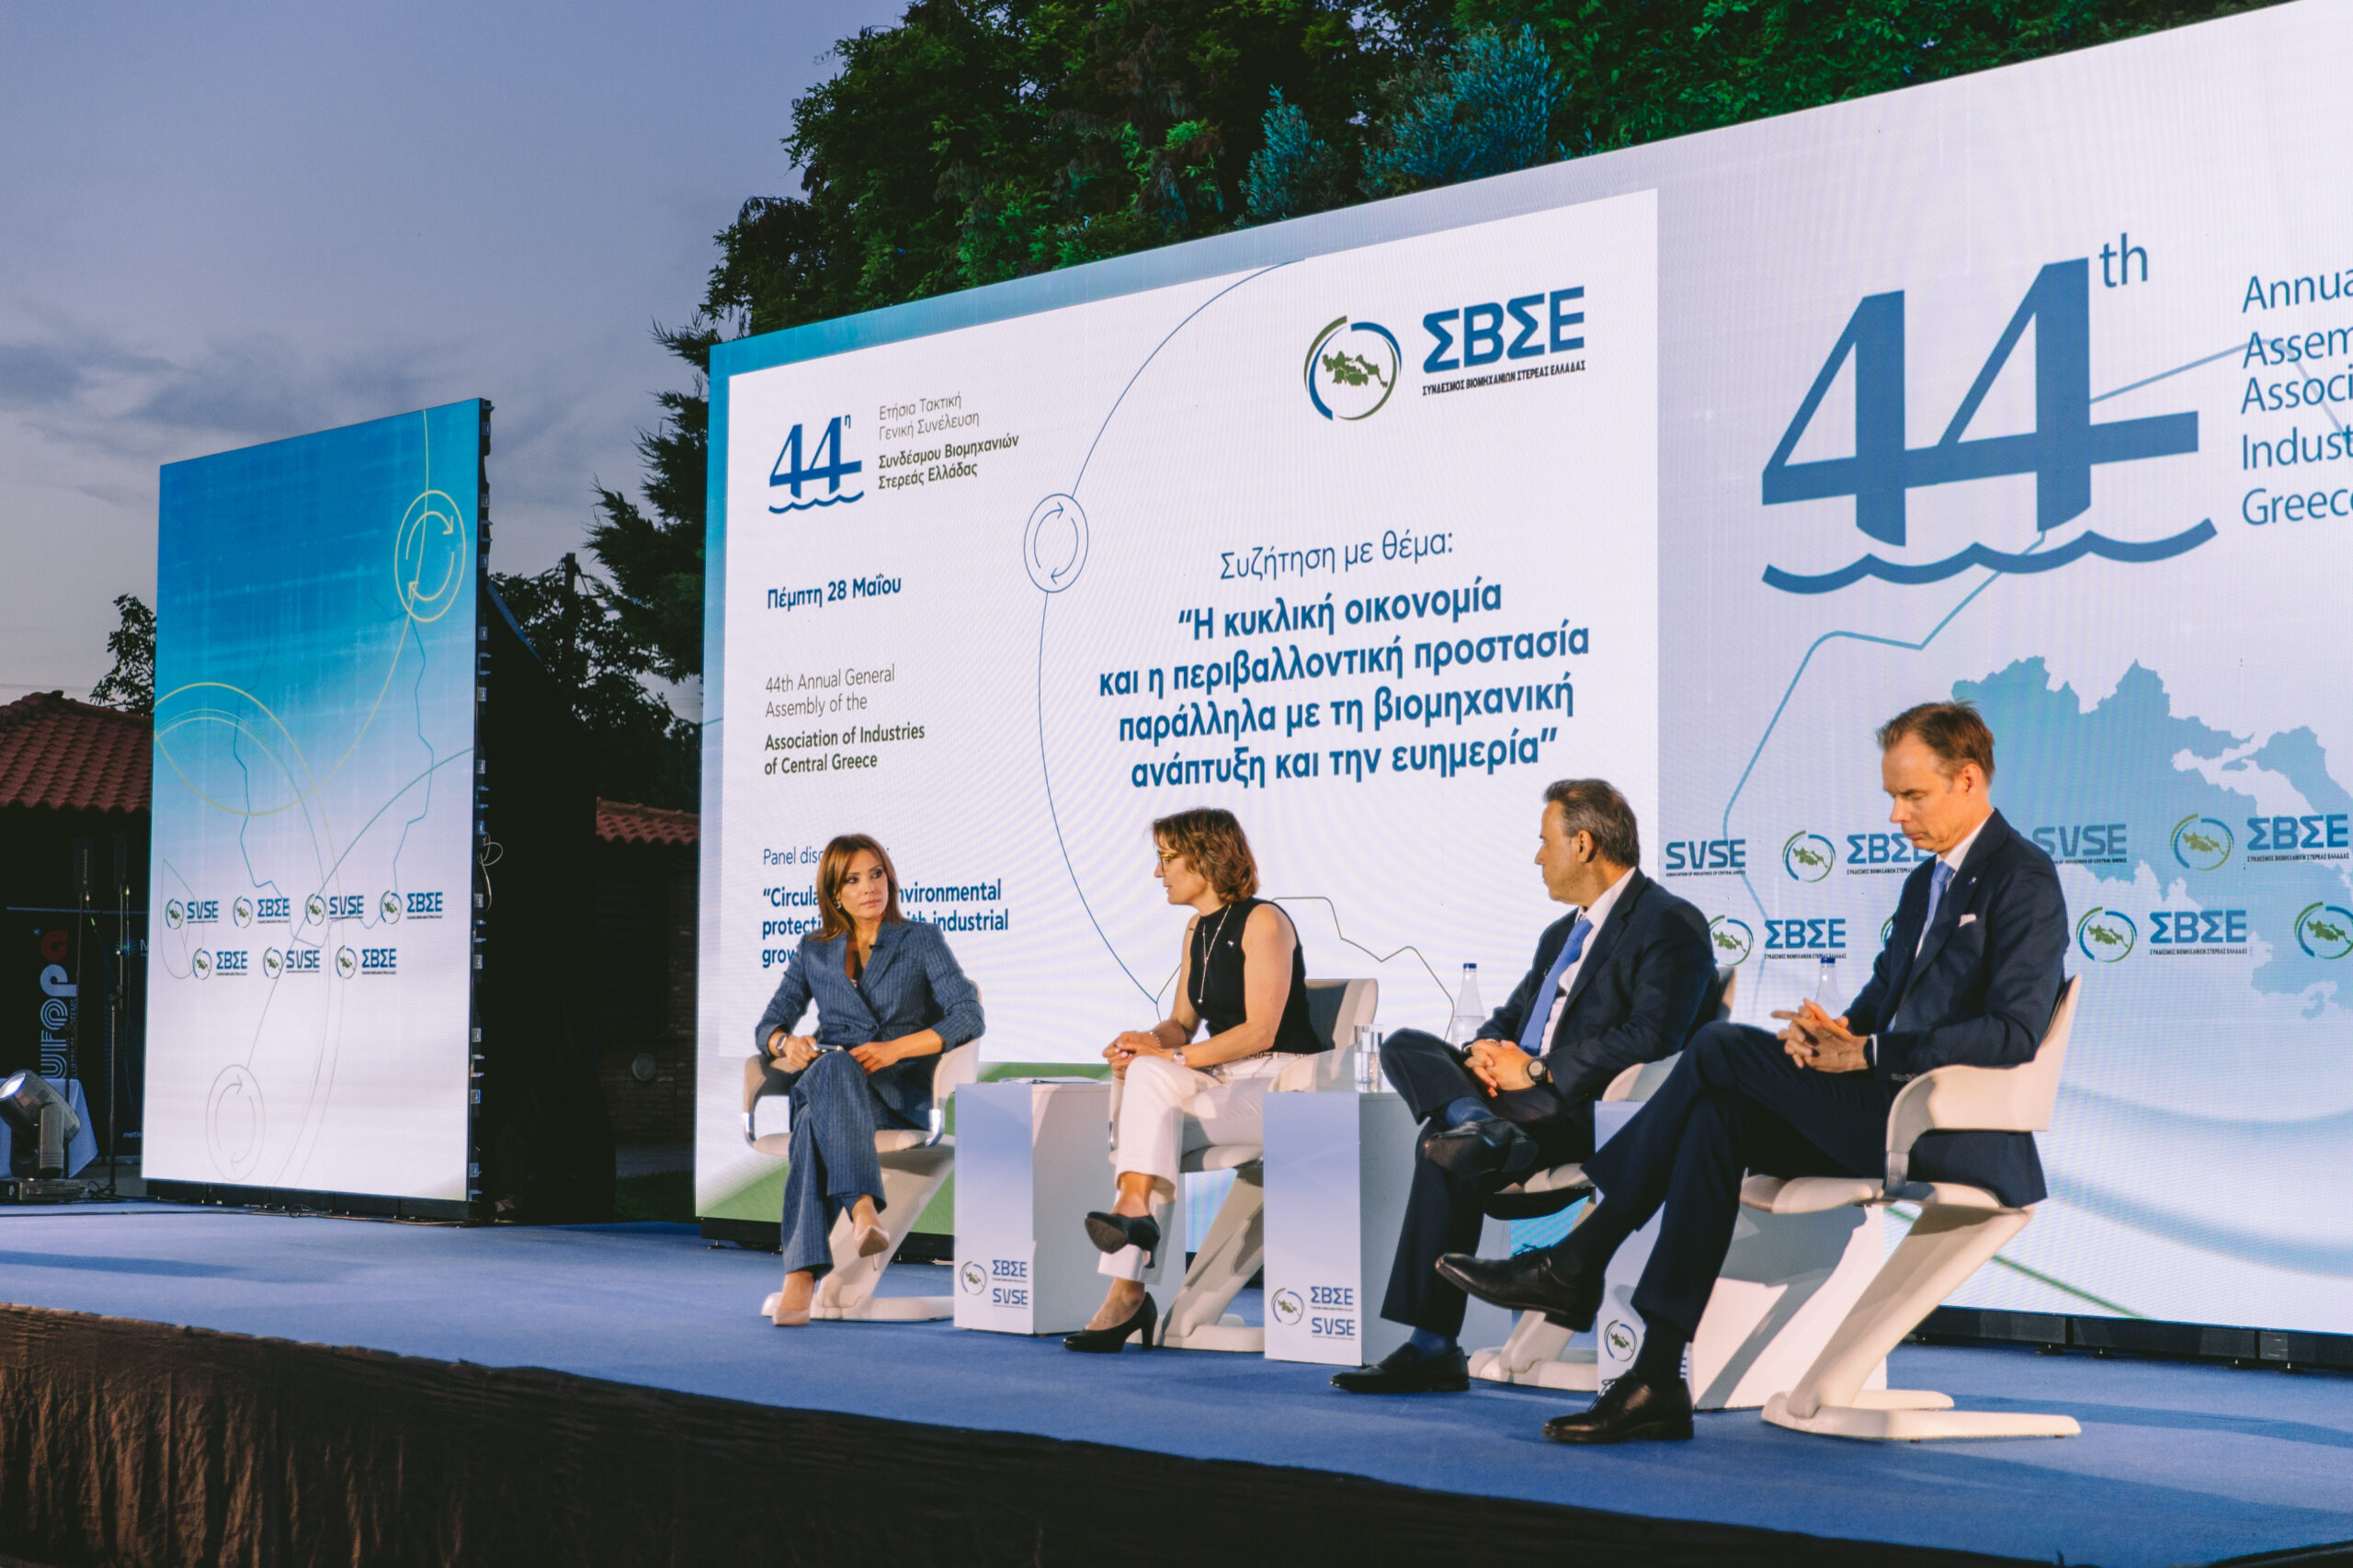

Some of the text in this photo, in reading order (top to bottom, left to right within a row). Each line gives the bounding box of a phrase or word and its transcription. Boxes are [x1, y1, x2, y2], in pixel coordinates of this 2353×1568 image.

[1422, 285, 1585, 375] ΣΒΣΕ
[1422, 360, 1586, 396] ΣΥΝΔΕΣΜΟΣ ΒΙΟΜΗΧΑΝΙΩΝ ΣΤΕΡΕΑΣ ΕΛΛΑΔΑΣ
[2241, 364, 2353, 415] Associ
[880, 391, 962, 421] Ετήσια Τακτική
[879, 412, 980, 441] Γενική Συνέλευση
[879, 433, 1019, 470] Συνδέσμου Βιομηχανιών
[879, 460, 978, 490] Στερεάς Ελλάδας
[2242, 488, 2353, 526] Greec
[1220, 529, 1454, 582] Συζήτηση με θέμα:
[767, 574, 902, 611] Πέμπτη 28 Μαΐου
[1178, 576, 1502, 641] “Η κυκλική οικονομία
[1100, 619, 1590, 699] και η περιβαλλοντική προστασία
[765, 663, 895, 693] 44th Annual General
[765, 692, 869, 718] Assembly of the
[1119, 672, 1574, 746] παράλληλα με τη βιομηχανική
[765, 722, 926, 751] Association of Industries
[764, 753, 878, 775] of Central Greece
[1131, 727, 1558, 789] ανάπτυξη και την ευημερία”
[2032, 824, 2127, 857] SVSE
[2247, 813, 2348, 851] ΣΒΣΕ
[763, 846, 797, 866] Panel
[1665, 838, 1745, 869] SVSE
[257, 898, 290, 917] ΣΒΣΕ
[329, 895, 364, 915] SVSE
[406, 892, 443, 913] ΣΒΣΕ
[763, 878, 1002, 907] “Circula nvironmental
[187, 901, 219, 919] SVSE
[762, 914, 823, 940] protecti
[933, 908, 1009, 932] industrial
[1765, 918, 1846, 949] ΣΒΣΕ
[2149, 910, 2247, 943] ΣΒΣΕ
[216, 950, 248, 970] ΣΒΣΕ
[286, 949, 320, 969] SVSE
[361, 949, 397, 968] ΣΒΣΕ
[762, 949, 795, 969] gro
[40, 930, 78, 1079] uropa
[993, 1259, 1028, 1278] ΣΒΣΕ
[993, 1288, 1029, 1305] SVSE
[1311, 1286, 1354, 1306] ΣΒΣΕ
[1312, 1317, 1356, 1336] SVSE
